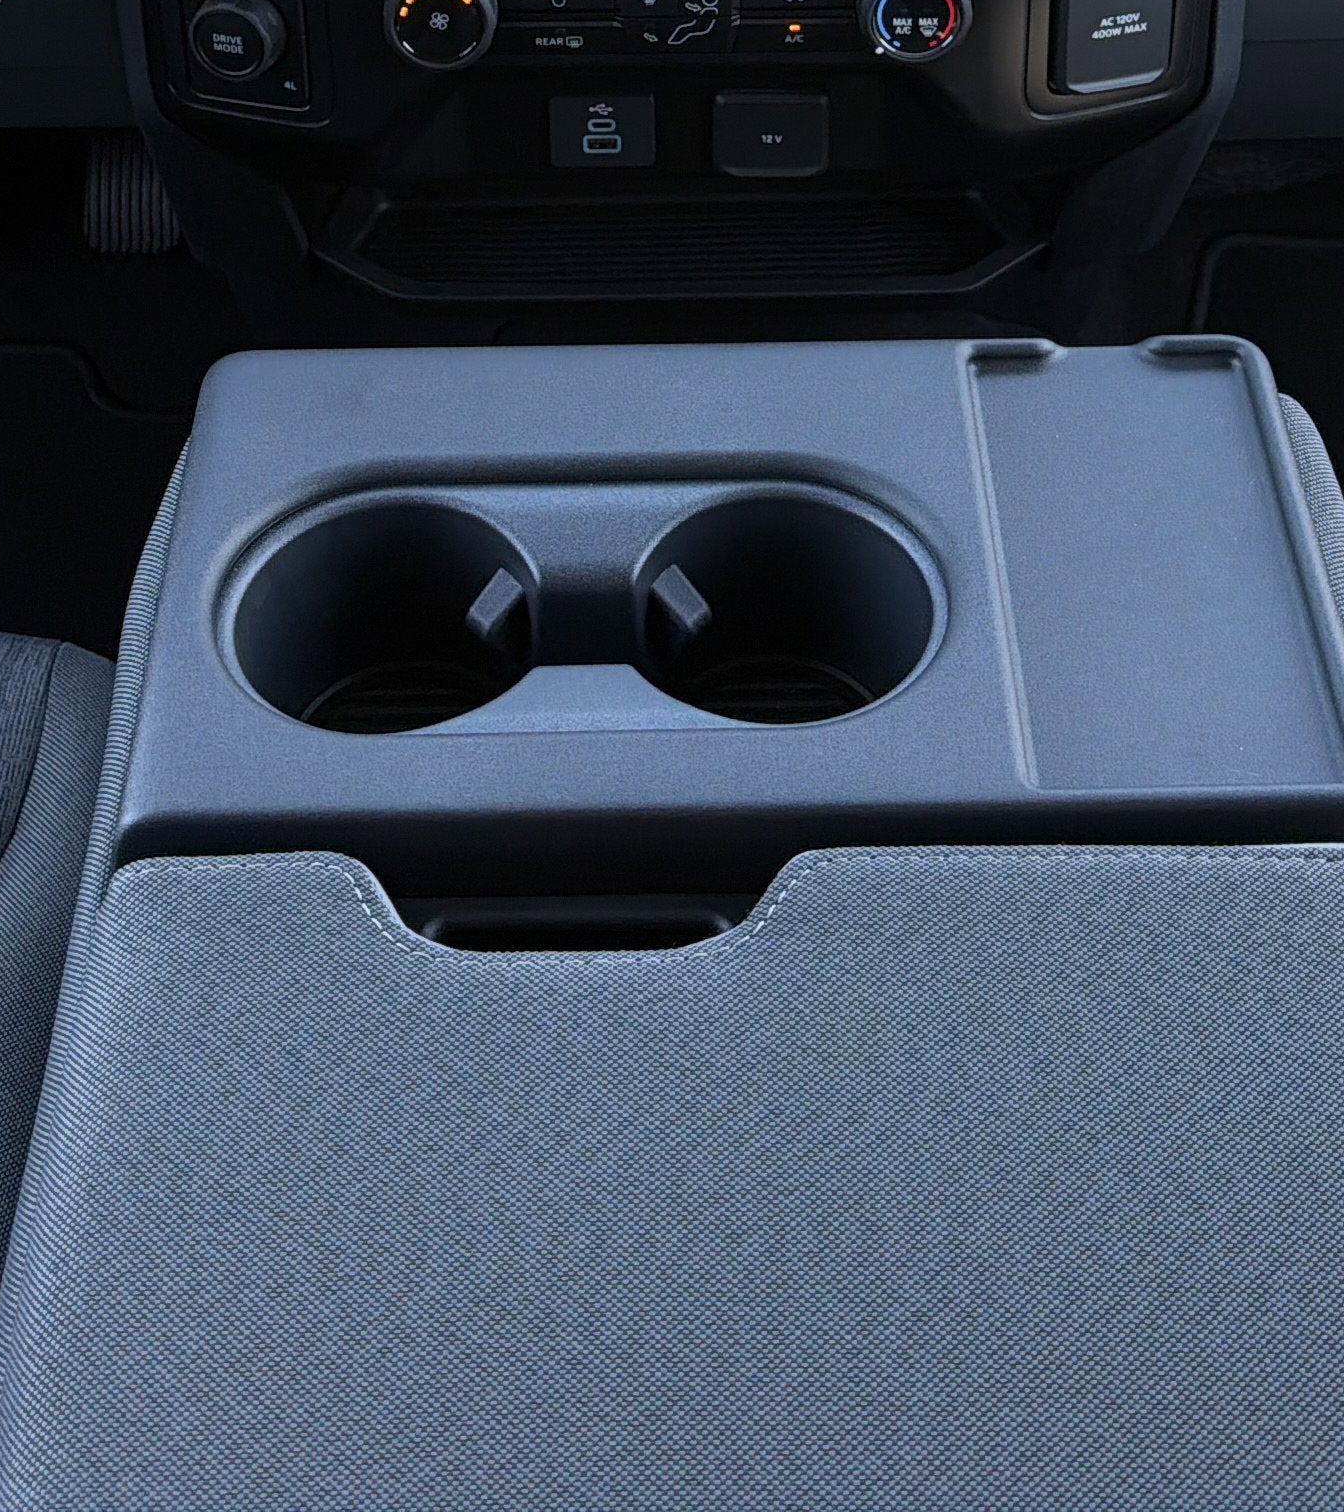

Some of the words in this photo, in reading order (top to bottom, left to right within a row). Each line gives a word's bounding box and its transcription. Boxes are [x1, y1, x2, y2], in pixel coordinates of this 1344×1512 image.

[892, 18, 912, 27] MAX
[918, 17, 939, 27] MAX
[1100, 16, 1114, 26] AC
[1116, 12, 1140, 25] 120V
[895, 26, 912, 35] A/C
[1091, 26, 1122, 39] 400W
[1123, 21, 1147, 34] MAX
[212, 33, 243, 45] DRIVE
[535, 37, 564, 46] REAR
[785, 35, 805, 44] A/C
[213, 43, 244, 54] MODE
[283, 81, 298, 91] 4L
[761, 134, 773, 144] 12
[774, 134, 783, 143] V
